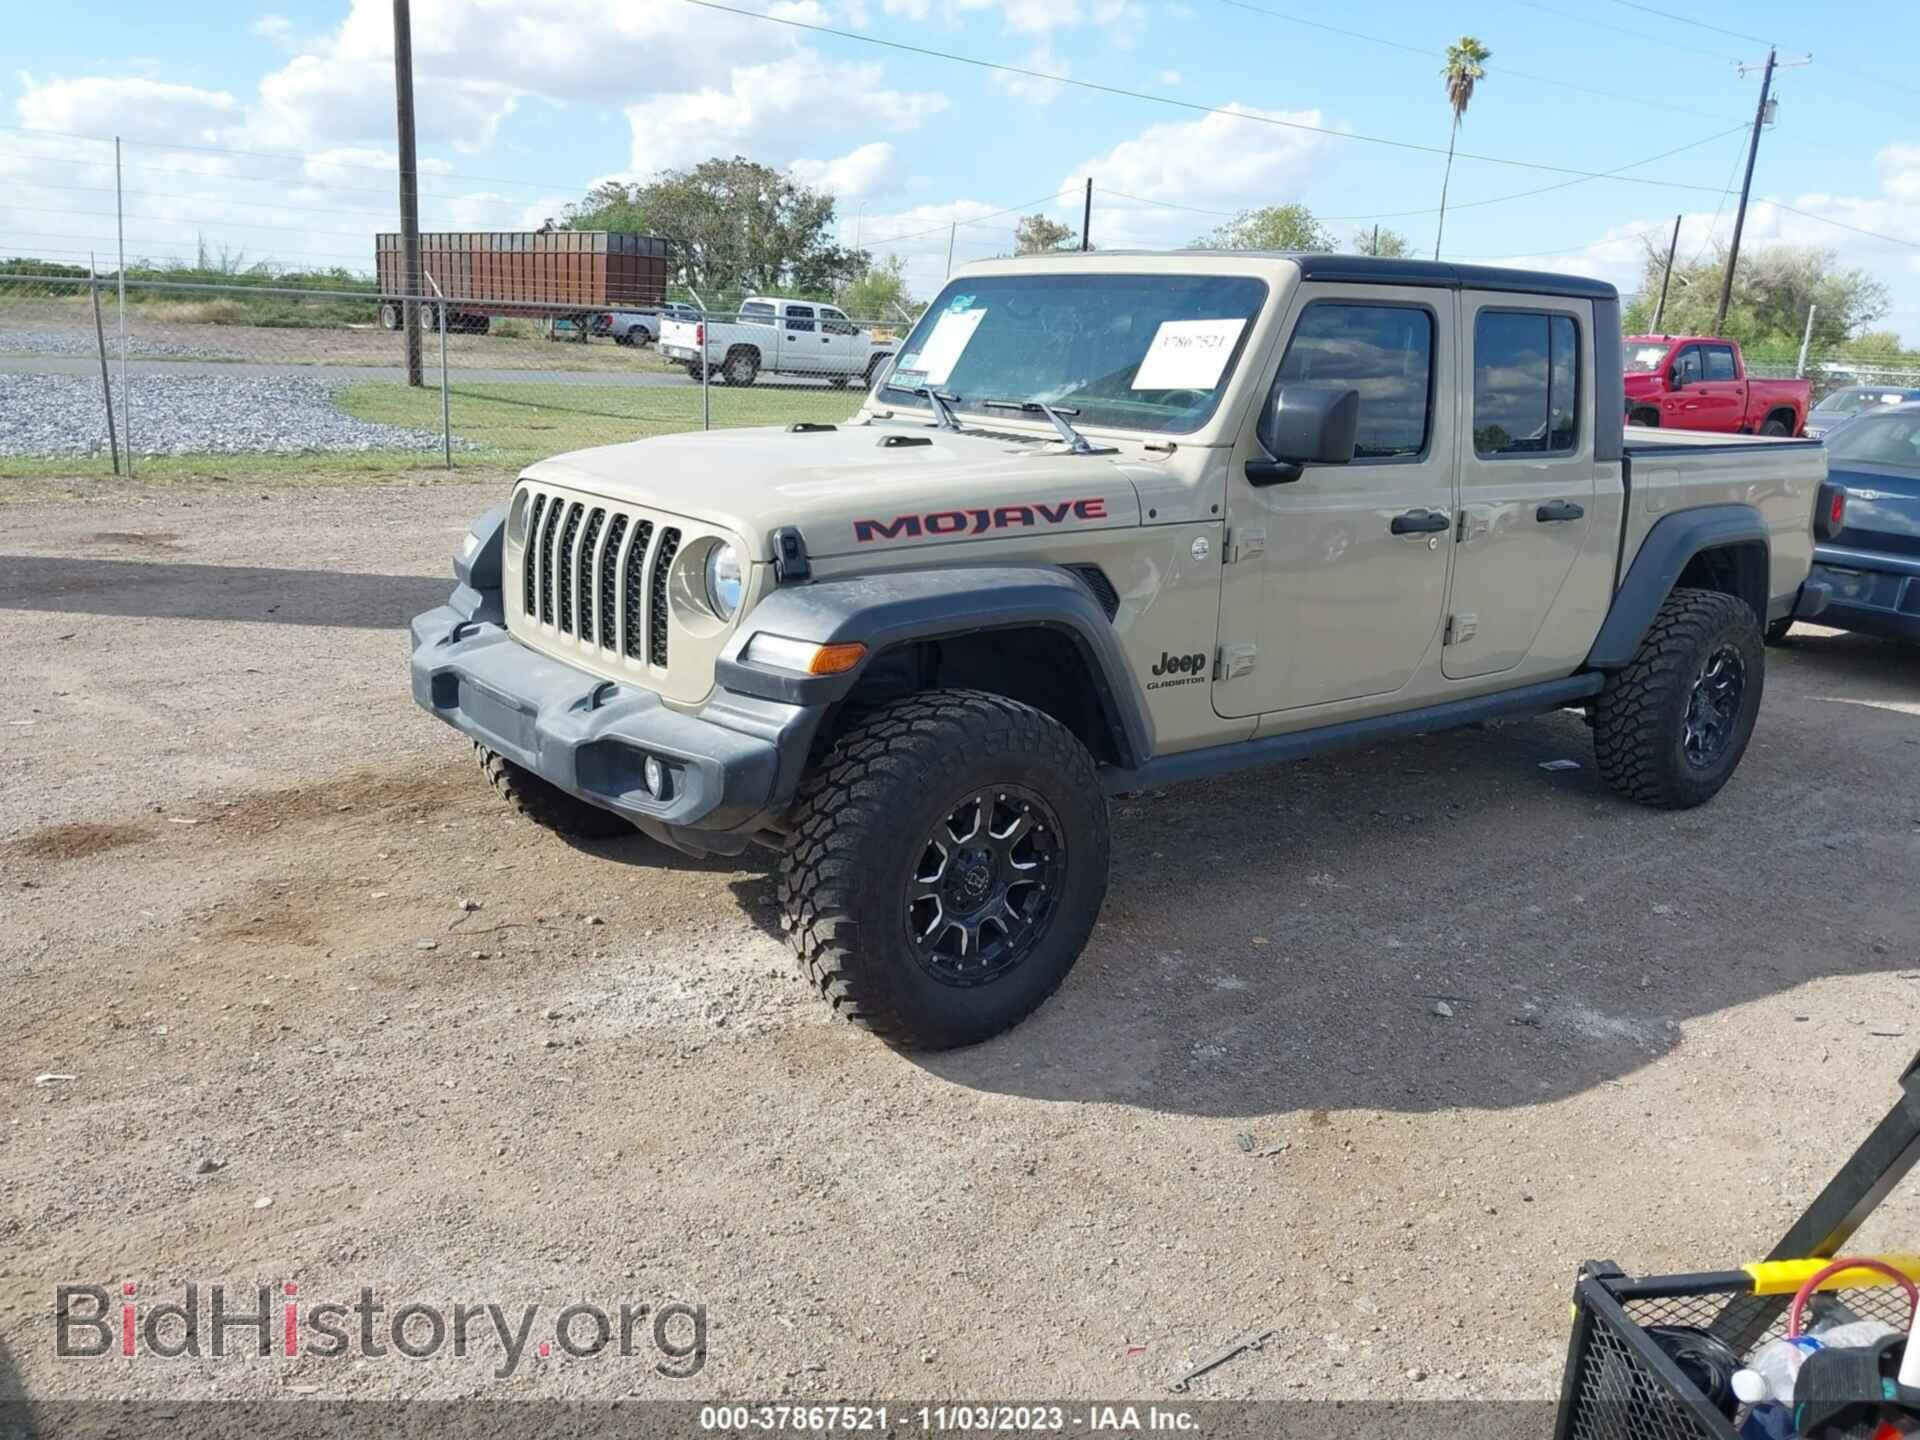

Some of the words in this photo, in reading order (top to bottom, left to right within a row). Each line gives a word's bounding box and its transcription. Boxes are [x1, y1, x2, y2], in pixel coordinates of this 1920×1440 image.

[853, 498, 1107, 542] MOJAVE
[1151, 651, 1206, 676] Jeep
[1146, 676, 1205, 690] GLADIATOR
